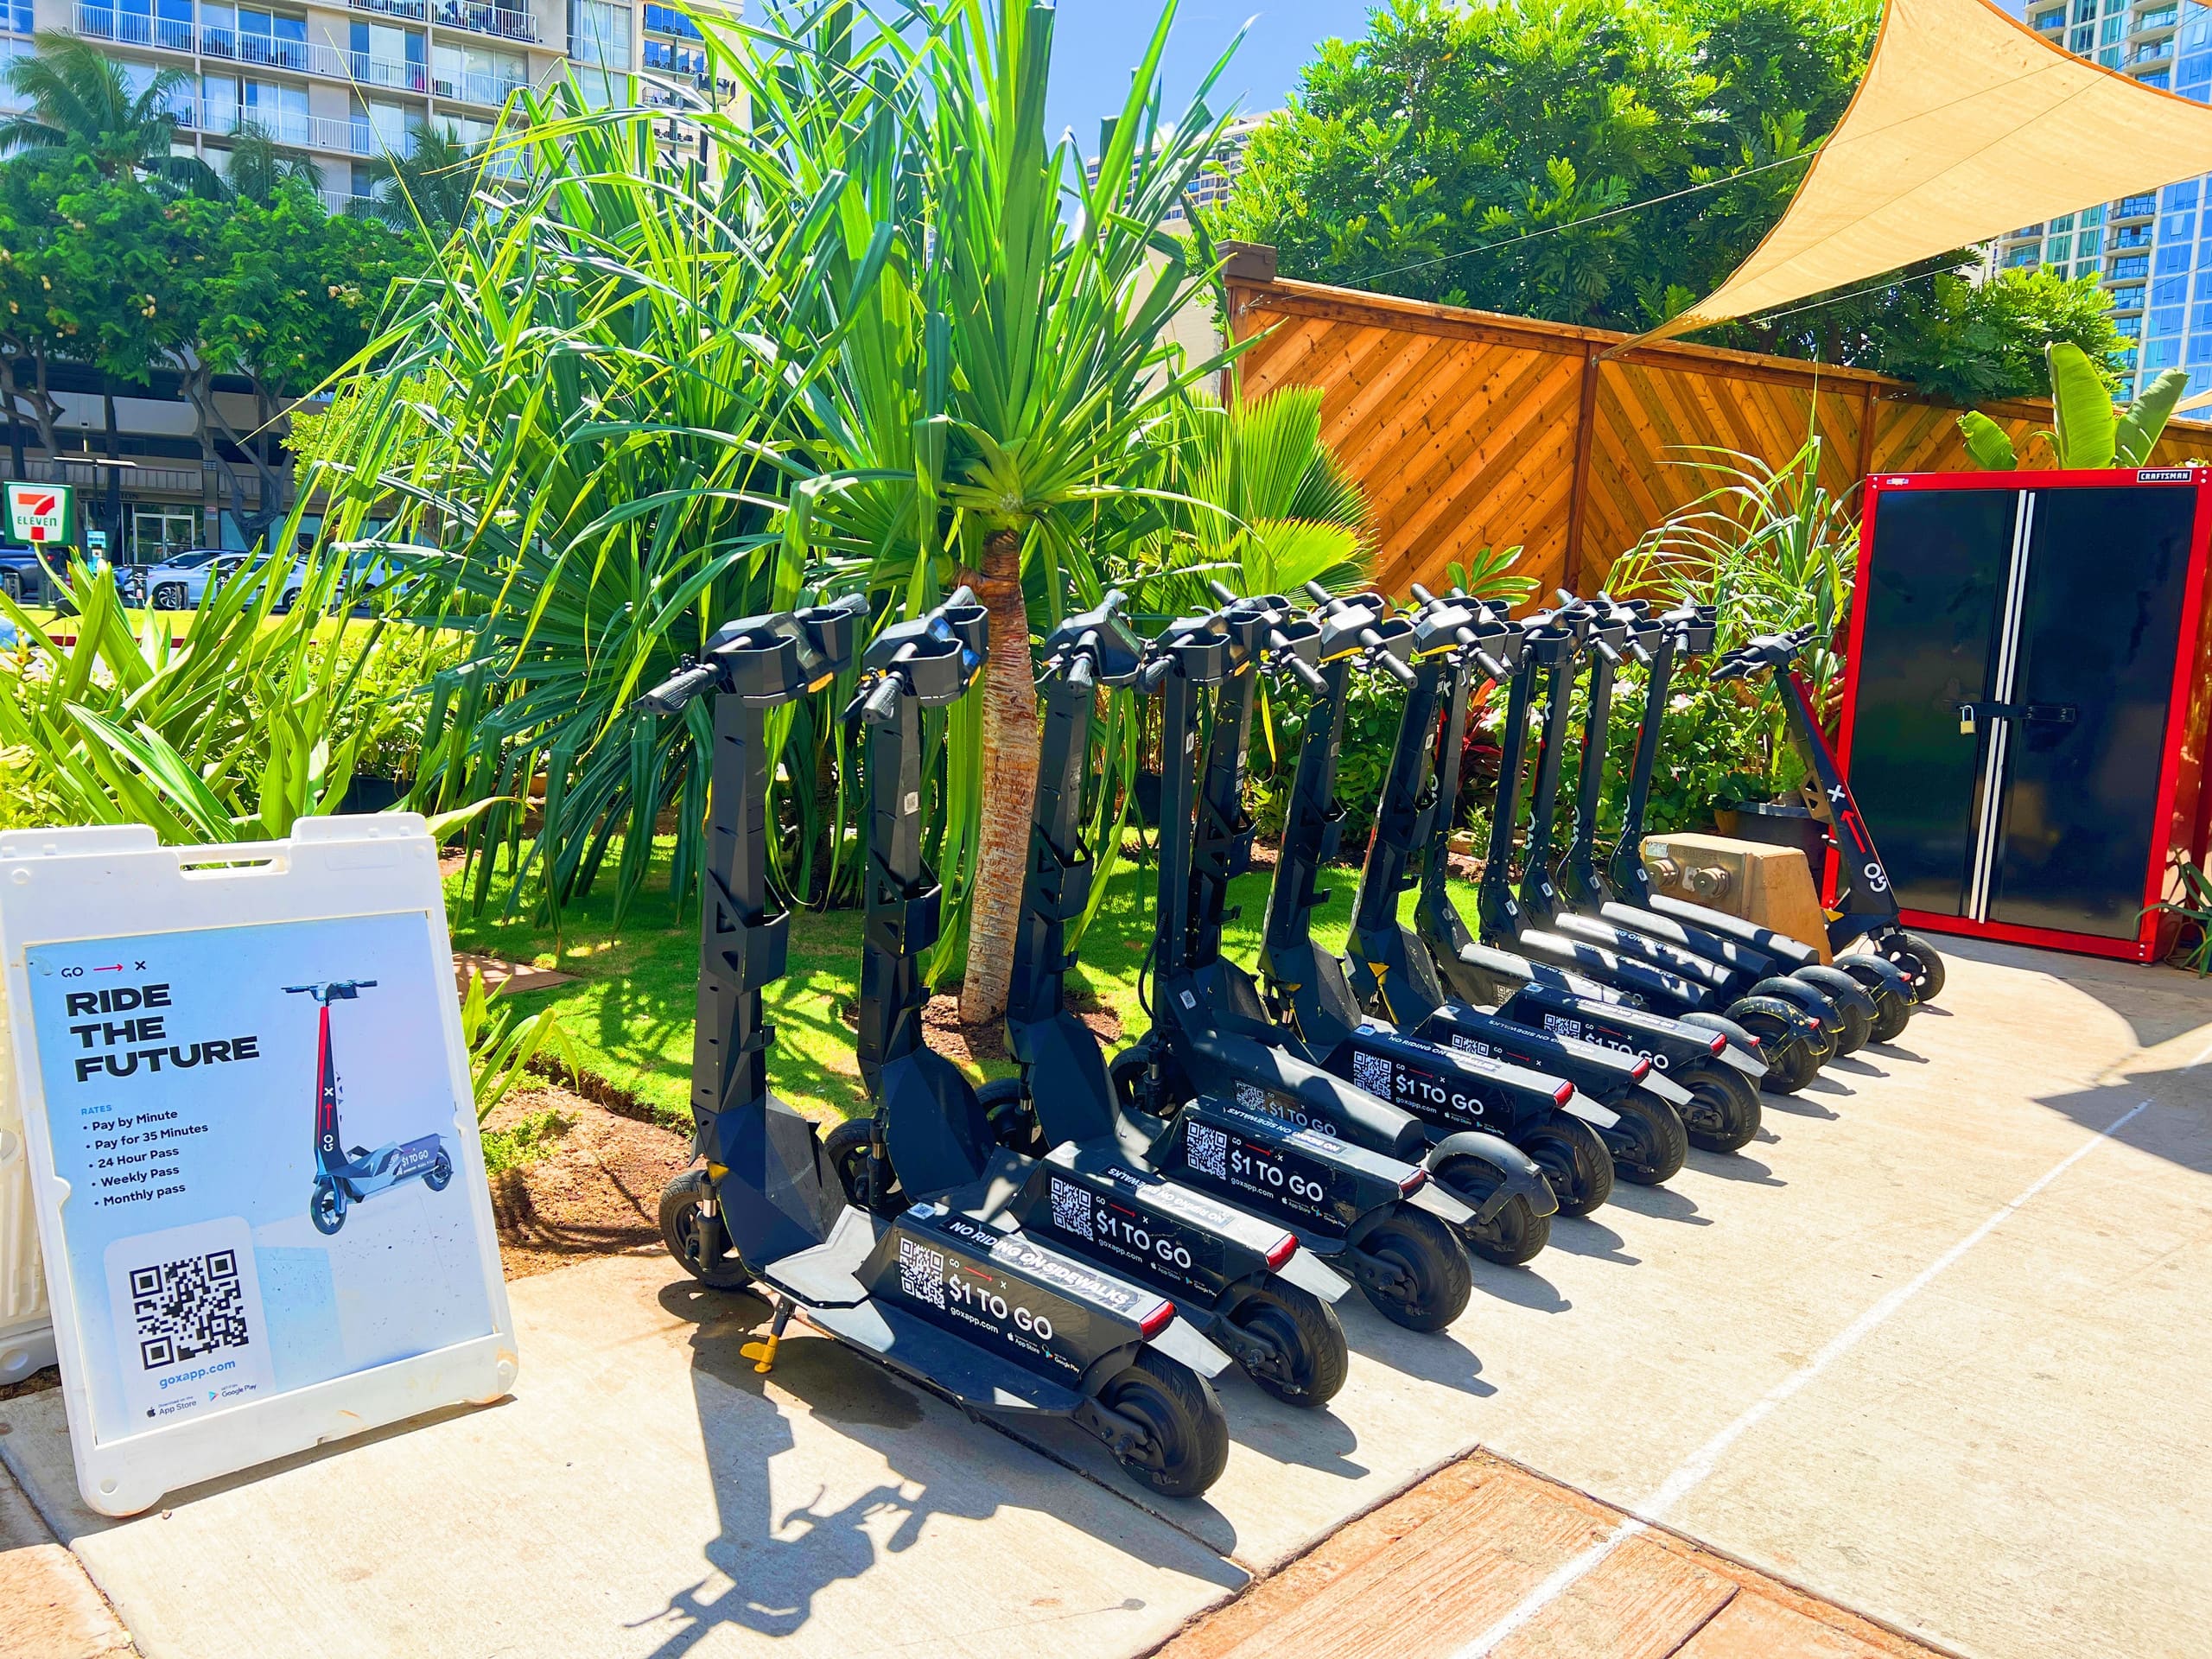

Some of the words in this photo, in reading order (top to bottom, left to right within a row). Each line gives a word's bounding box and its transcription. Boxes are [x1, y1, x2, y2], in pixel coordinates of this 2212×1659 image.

[2140, 472, 2189, 480] CRAFTSMAN
[17, 493, 55, 540] 7
[1864, 862, 1887, 893] GO
[60, 967, 84, 978] GO
[134, 960, 147, 971] X
[66, 982, 172, 1017] RIDE
[70, 1015, 167, 1049] THE
[1402, 1039, 1432, 1052] RIDING
[1432, 1047, 1446, 1056] ON
[74, 1035, 260, 1083] FUTURE
[1638, 1050, 1669, 1070] GO
[1395, 1074, 1414, 1095] $1
[1420, 1082, 1446, 1103] TO
[1452, 1094, 1484, 1116] GO
[1395, 1096, 1437, 1114] goxapp.com
[80, 1104, 112, 1116] RATES
[92, 1121, 115, 1131] Pay
[118, 1117, 133, 1128] by
[136, 1110, 179, 1124] Minute
[1268, 1101, 1284, 1118] $1
[1287, 1109, 1308, 1126] TO
[1312, 1119, 1337, 1137] GO
[95, 1139, 118, 1150] Pay
[120, 1135, 140, 1146] for
[143, 1131, 158, 1142] 35
[160, 1124, 209, 1139] Minutes
[1276, 1125, 1293, 1134] ON
[98, 1158, 114, 1168] 24
[117, 1153, 147, 1166] Hour
[149, 1147, 180, 1160] Pass
[418, 1149, 429, 1160] GO
[100, 1171, 148, 1187] Weekly
[150, 1166, 180, 1179] Pass
[1230, 1150, 1250, 1175] $1
[1255, 1160, 1284, 1186] TO
[1288, 1175, 1324, 1202] GO
[103, 1189, 154, 1206] Monthly
[156, 1185, 187, 1198] pass
[1230, 1177, 1274, 1199] goxapp.com
[1096, 1196, 1106, 1205] GO
[1096, 1210, 1117, 1236] $1
[1122, 1222, 1150, 1250] TO
[1155, 1239, 1192, 1268] GO
[1098, 1238, 1143, 1263] goxapp.com
[949, 1258, 960, 1268] GO
[949, 1222, 974, 1236] NO
[972, 1231, 1023, 1257] RIDING
[1020, 1251, 1044, 1268] ON
[1042, 1262, 1130, 1306] SIDEWALKS
[949, 1274, 971, 1305] $1
[976, 1287, 1007, 1319] TO
[1014, 1306, 1052, 1340] GO
[950, 1306, 999, 1334] goxapp.com
[159, 1360, 236, 1389] goxapp.com
[221, 1387, 243, 1397] Google
[158, 1406, 175, 1416] App
[176, 1400, 197, 1411] Store
